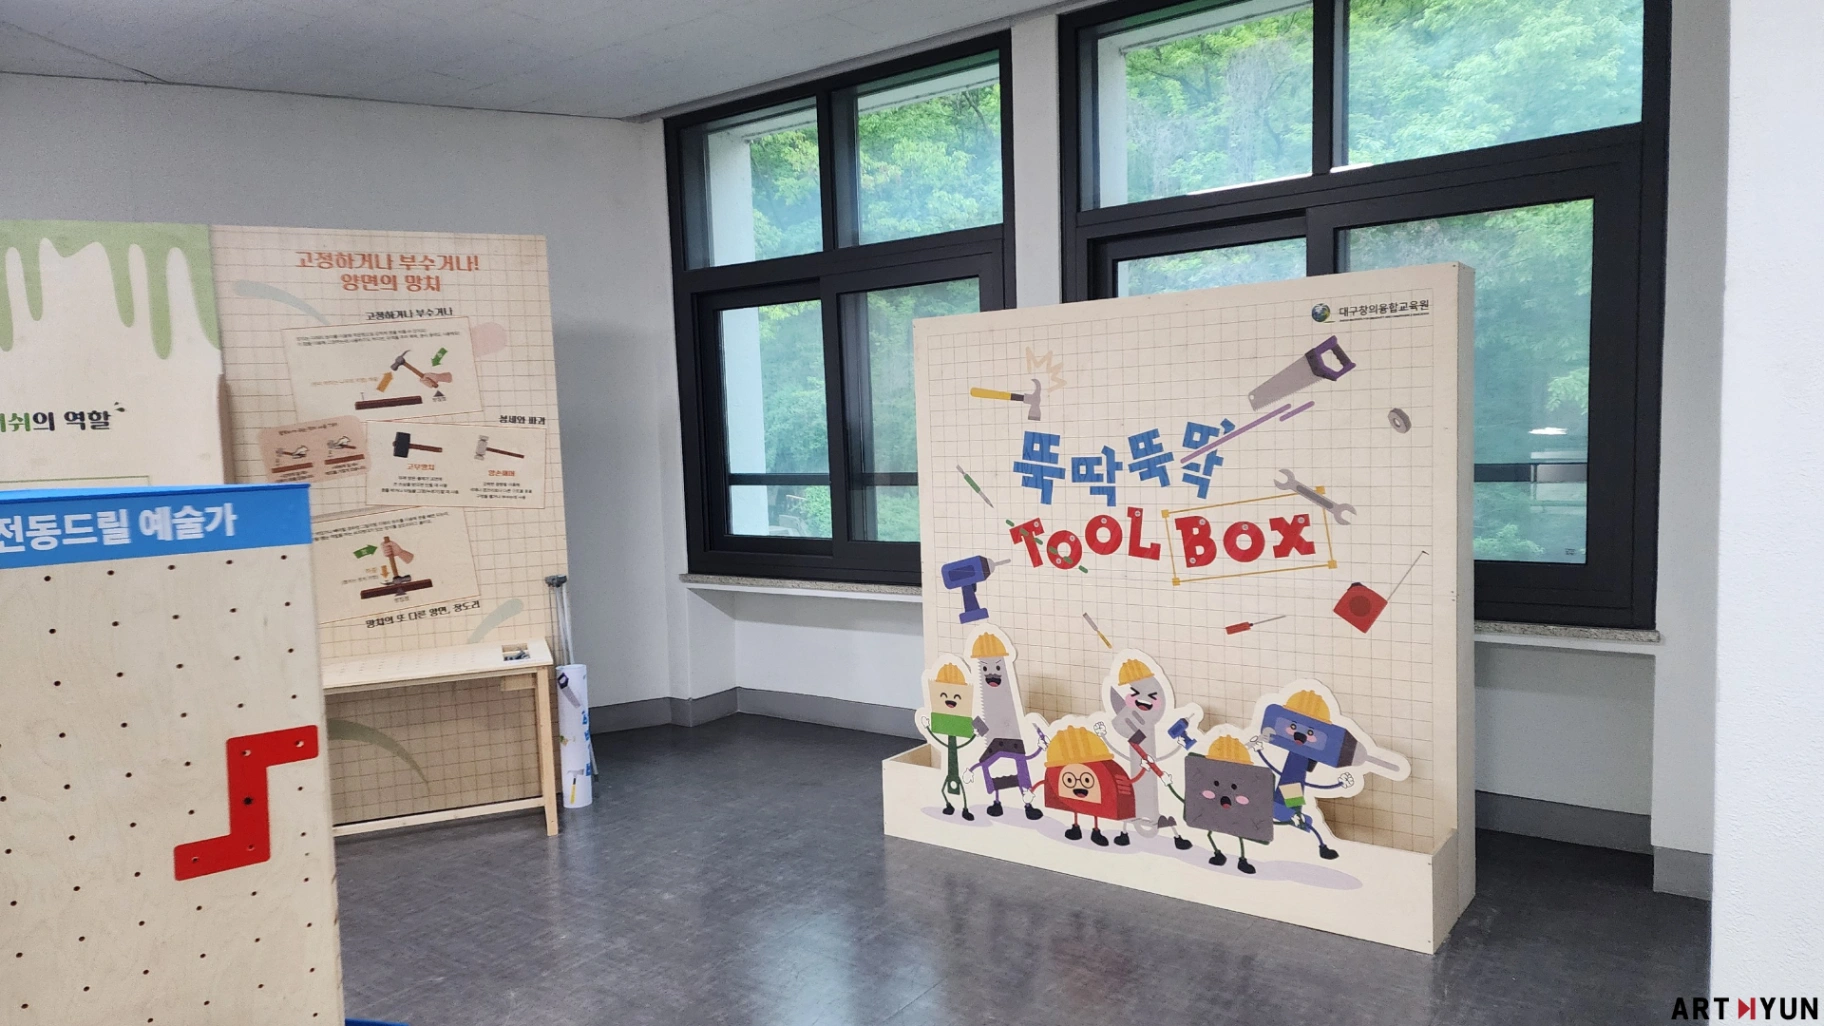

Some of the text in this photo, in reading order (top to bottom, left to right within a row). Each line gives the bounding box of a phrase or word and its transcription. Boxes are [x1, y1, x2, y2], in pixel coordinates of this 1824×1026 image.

[296, 251, 479, 272] 고정하거나 부수거나!
[341, 273, 442, 292] 양면의 망치
[365, 307, 453, 321] 고정하거나 부수거나
[1339, 299, 1429, 317] 대구창의융합교육원
[0, 410, 111, 432] 쉬의 역할
[0, 503, 238, 553] 전동드릴 예술가
[1009, 506, 1316, 570] TOOL BOX
[365, 615, 394, 628] 망치의
[396, 613, 407, 622] 또
[408, 609, 427, 621] 다른
